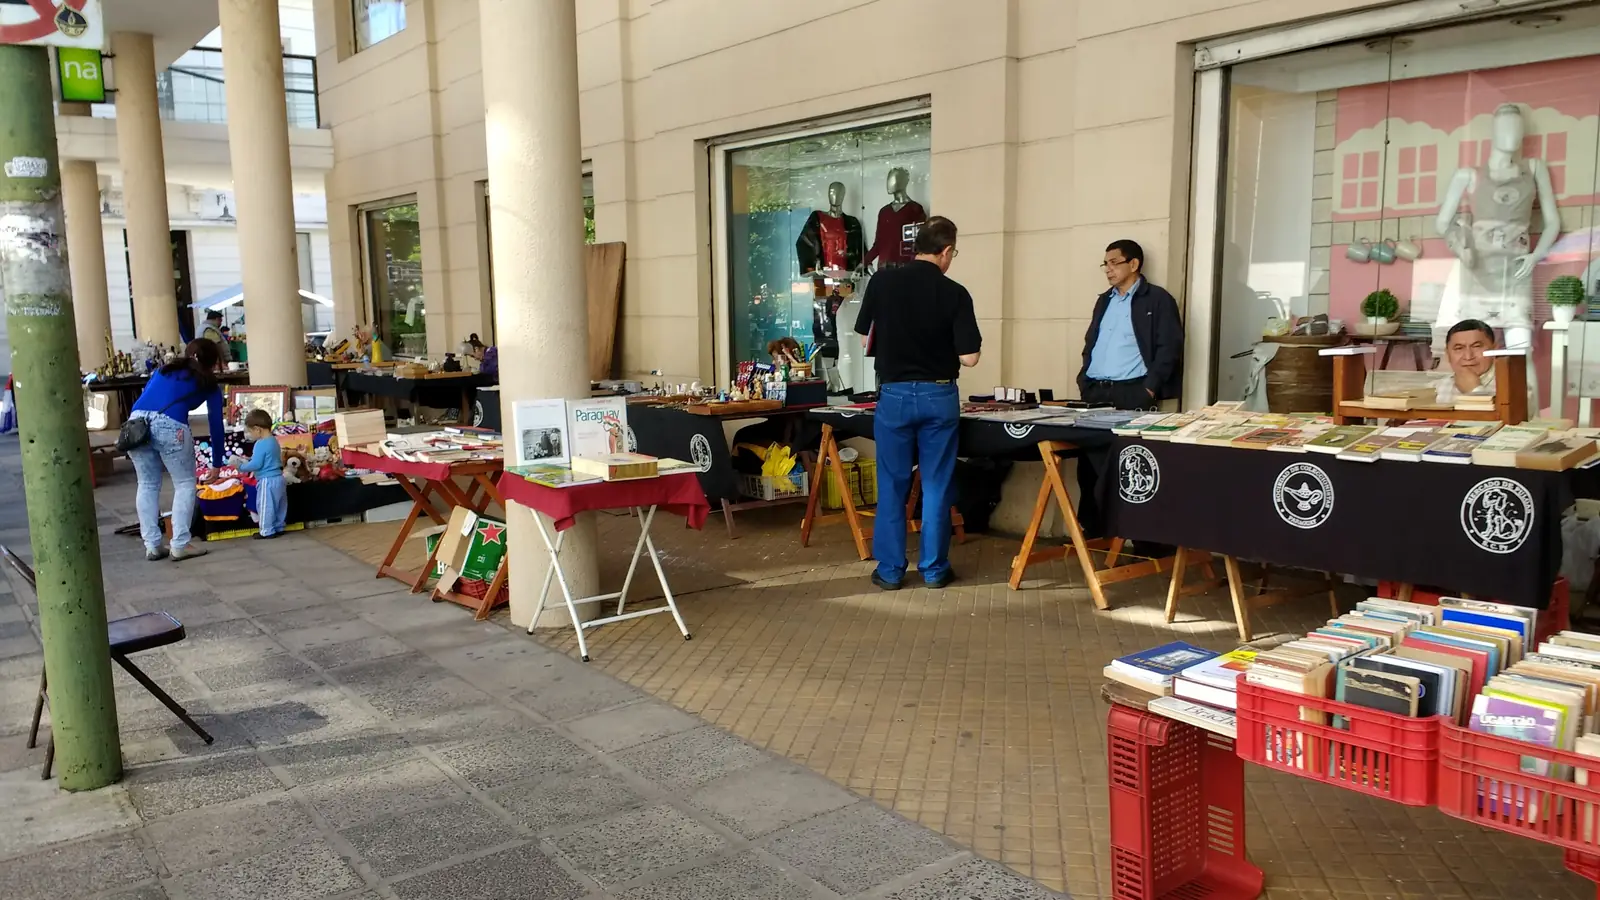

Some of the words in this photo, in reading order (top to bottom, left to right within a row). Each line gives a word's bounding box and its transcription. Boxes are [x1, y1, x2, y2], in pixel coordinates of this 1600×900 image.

[64, 60, 98, 80] na
[575, 408, 620, 424] Paraguay
[1466, 481, 1500, 505] MERCADO
[1501, 481, 1514, 490] DE
